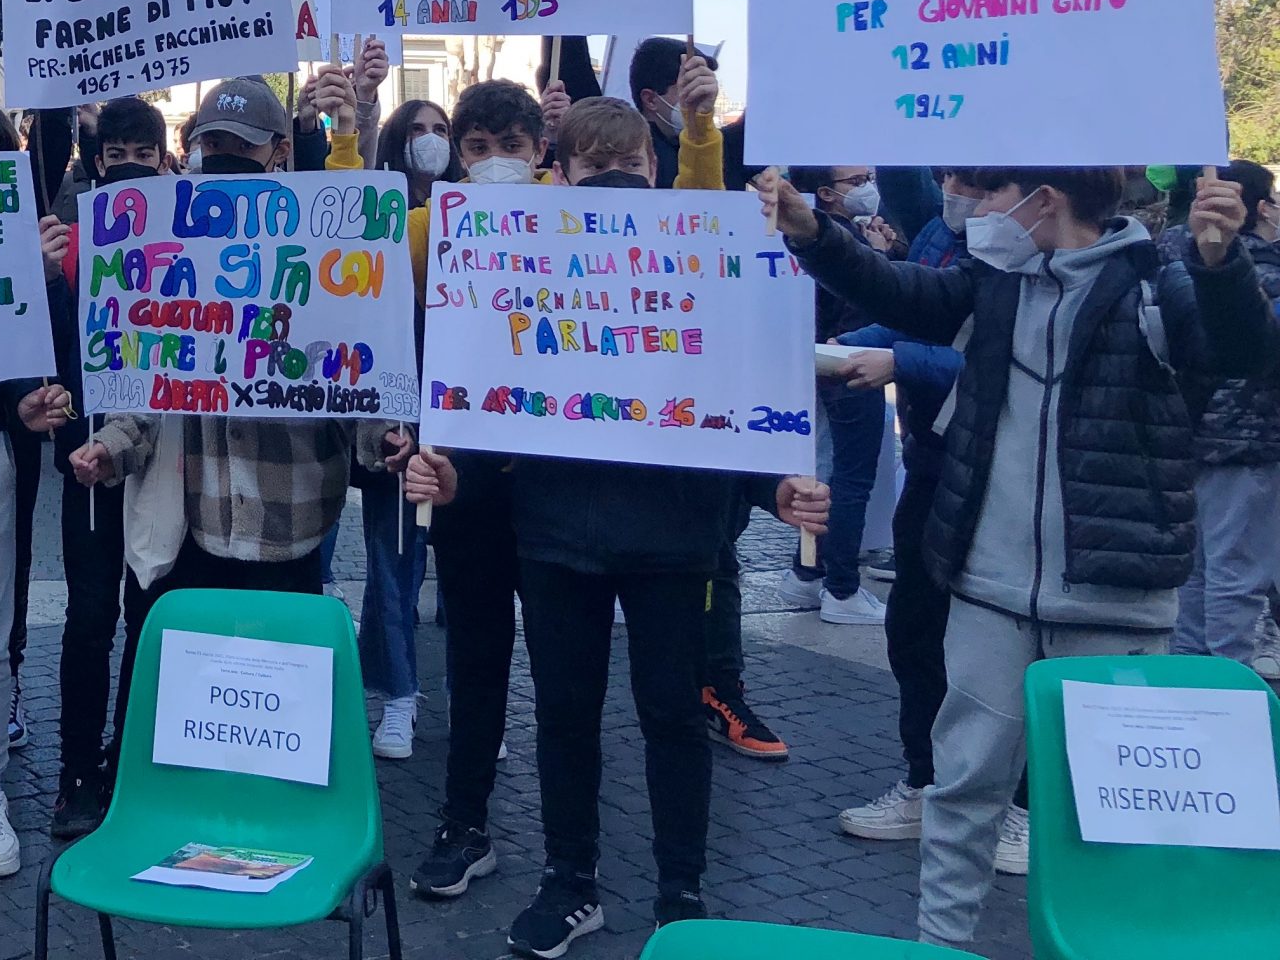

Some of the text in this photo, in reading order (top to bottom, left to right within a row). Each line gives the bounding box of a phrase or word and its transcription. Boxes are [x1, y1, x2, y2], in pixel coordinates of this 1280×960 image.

[36, 7, 131, 48] FARNE
[836, 0, 887, 32] PER
[28, 39, 145, 78] PER: MICHELE
[891, 32, 1010, 70] 12 ANNI
[77, 56, 190, 95] 1967 1975
[895, 93, 964, 120] 1947
[93, 179, 406, 246] LA LOTTA ALLA
[440, 191, 637, 238] PARLATE DELLA
[90, 242, 384, 306] MAFIA FA CON
[437, 240, 617, 277] PARLATENE ALLA
[426, 281, 477, 308] SUI
[129, 298, 292, 341] CULTURA PER
[508, 312, 702, 355] PARLATENE
[83, 330, 374, 386] SENTIRE PROFUMO
[84, 371, 254, 412] DELLA X
[430, 381, 811, 435] PER ARTURO 16 2006
[210, 686, 280, 711] POSTO
[184, 719, 301, 752] RISERVATO
[1117, 744, 1201, 770] POSTO
[1098, 786, 1236, 814] RISERVATO
